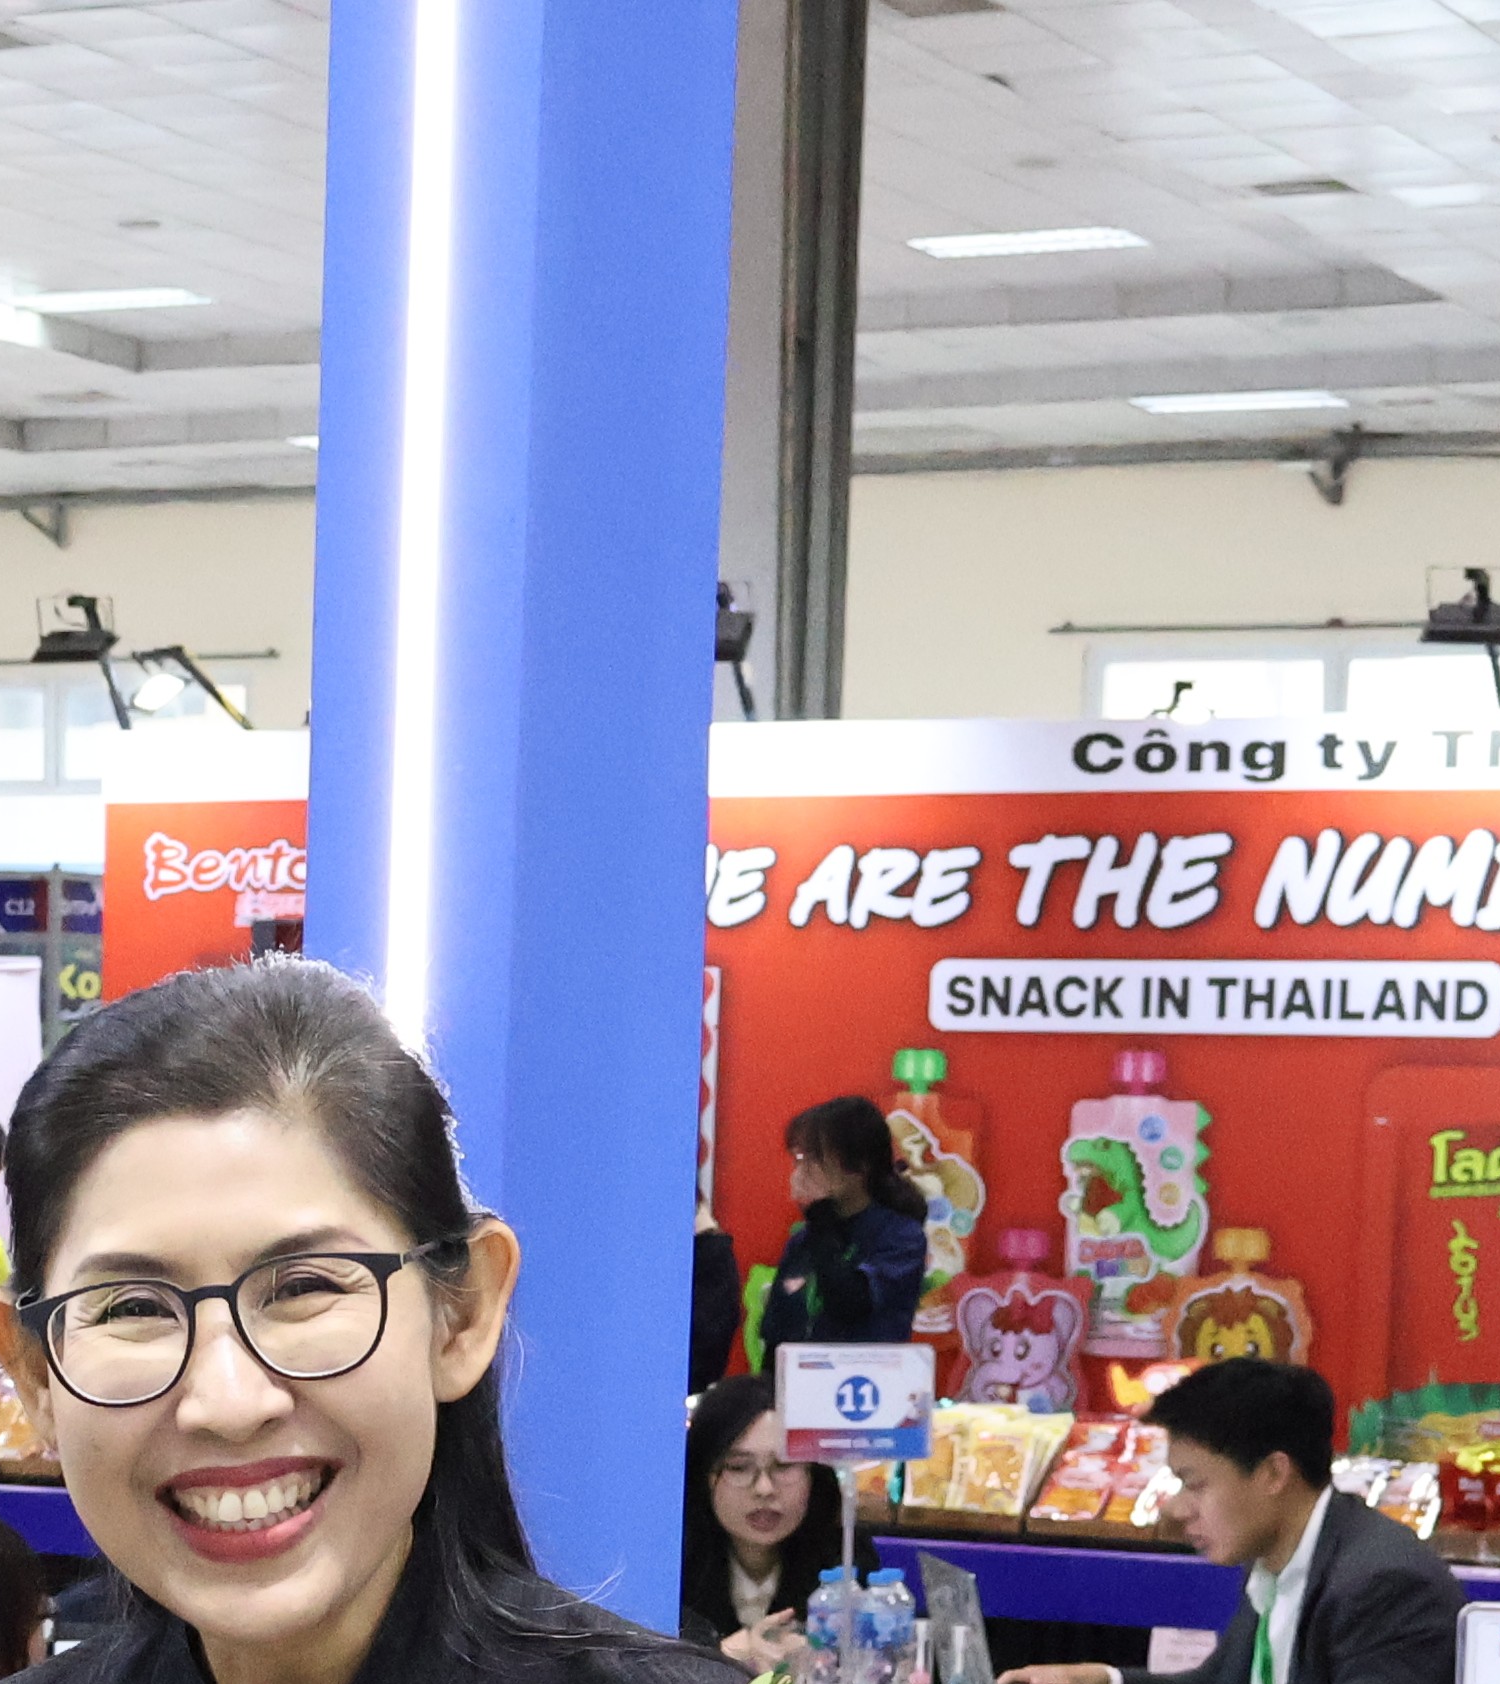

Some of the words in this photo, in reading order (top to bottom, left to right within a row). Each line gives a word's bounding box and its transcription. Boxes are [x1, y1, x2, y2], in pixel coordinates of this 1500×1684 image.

[1073, 728, 1287, 782] Công
[1318, 733, 1397, 780] ty
[705, 843, 777, 928] E
[788, 843, 982, 931] ARE
[1007, 830, 1235, 931] THE
[946, 976, 1124, 1020] SNACK
[1141, 977, 1191, 1019] IN
[1208, 977, 1490, 1022] THAILAND
[837, 1382, 878, 1413] 11
